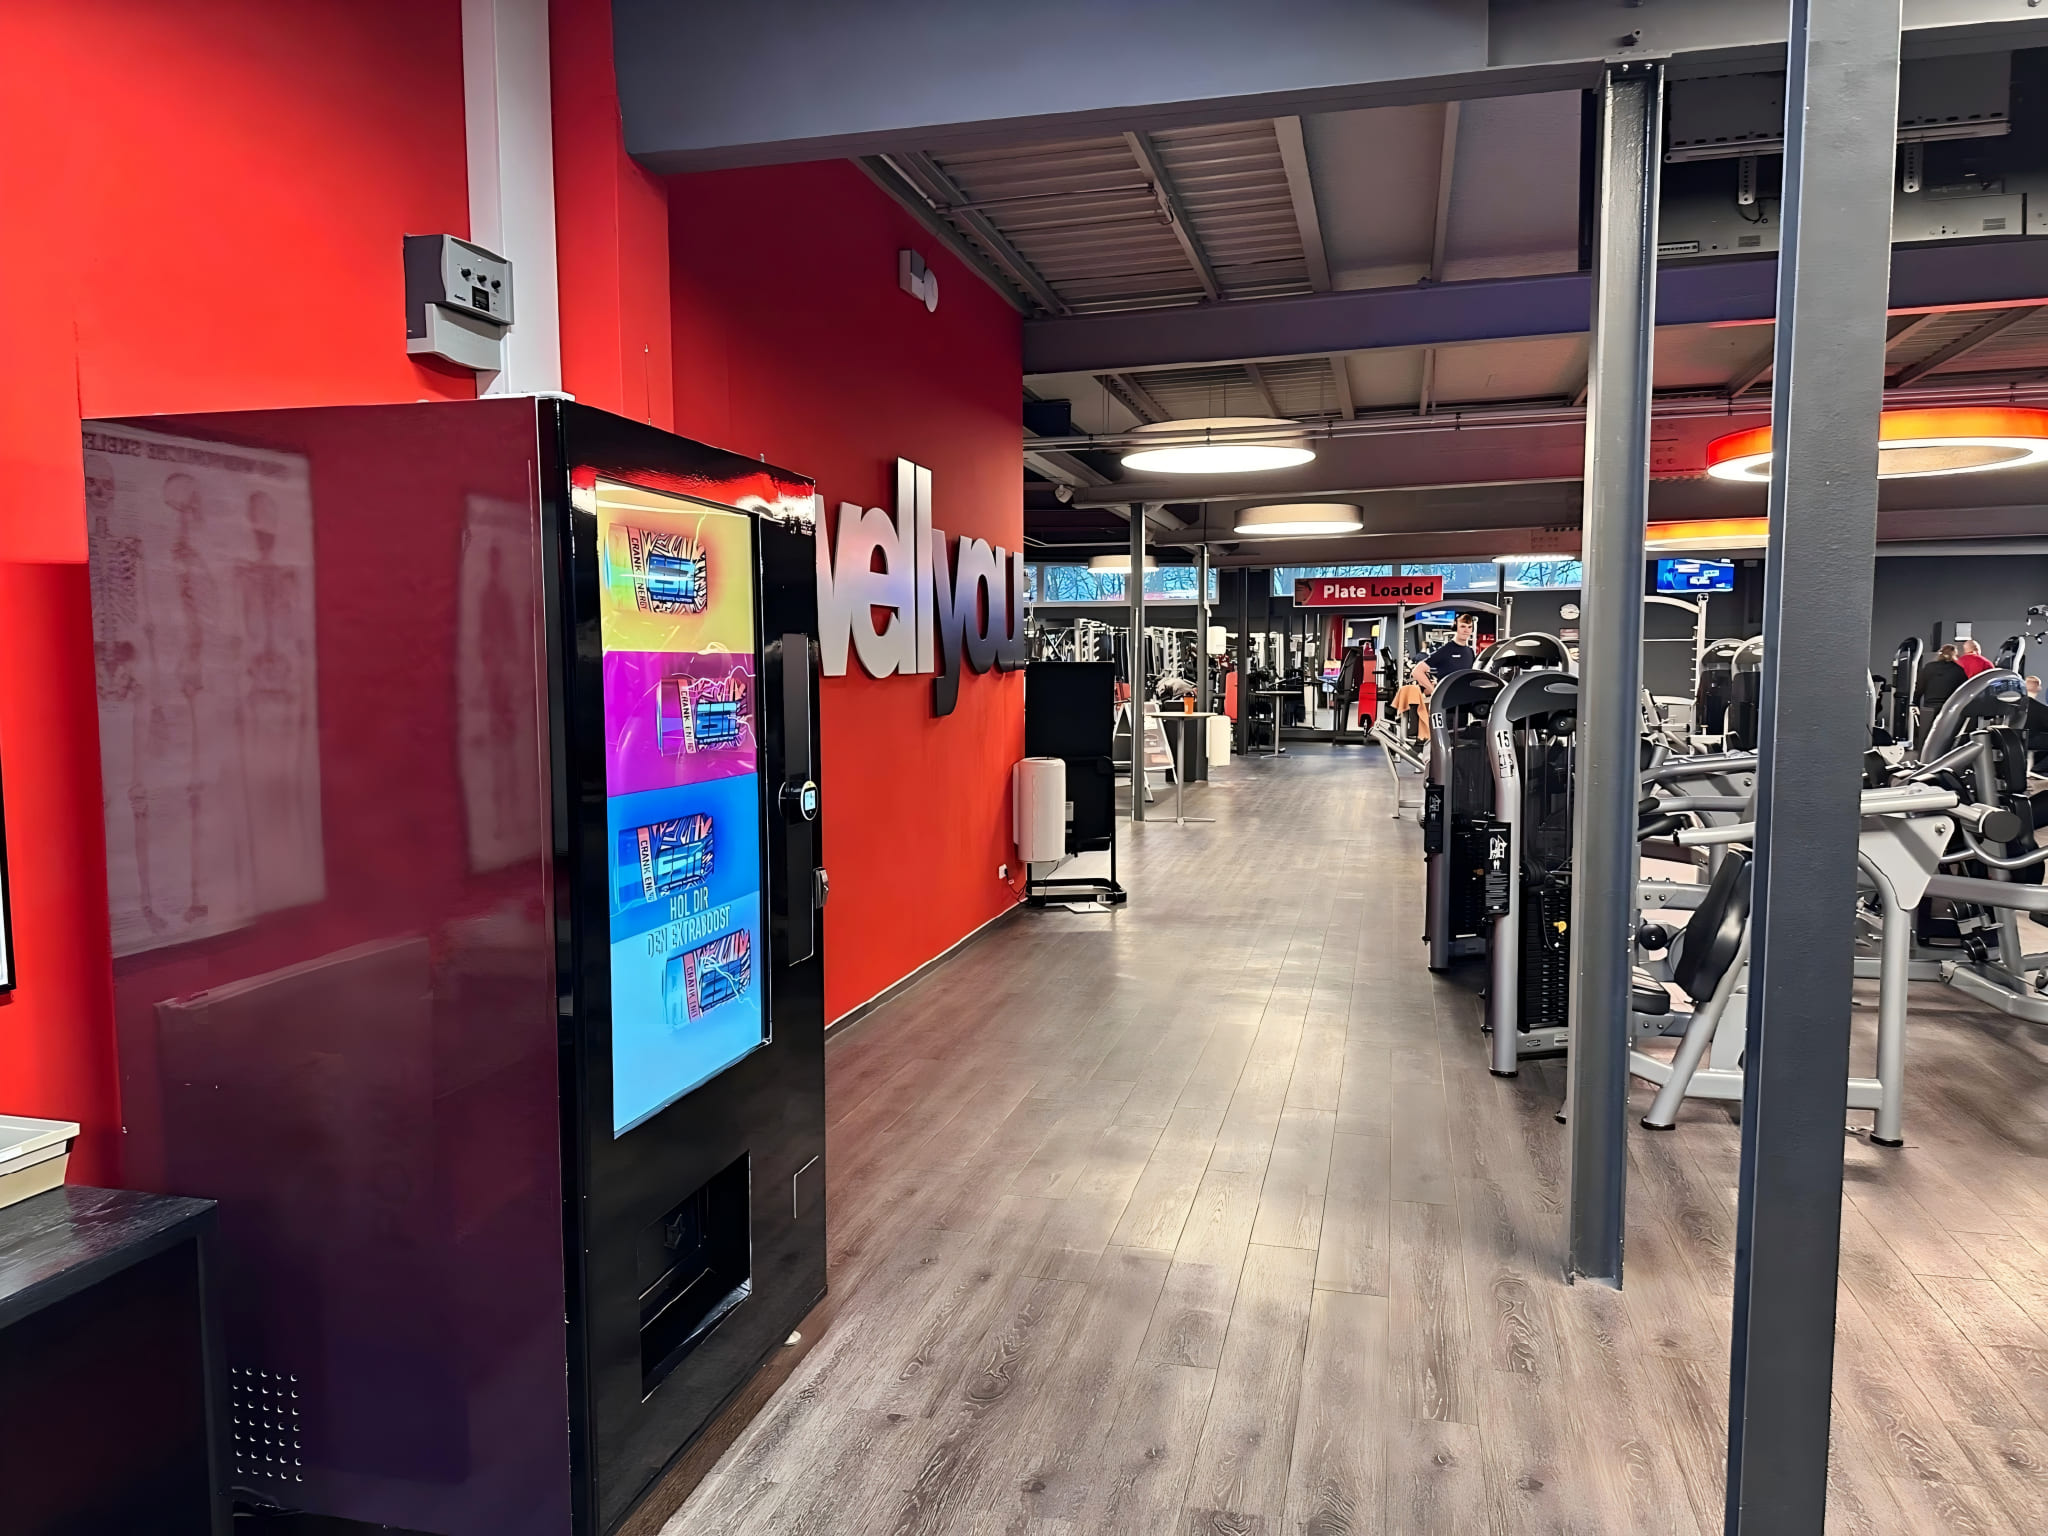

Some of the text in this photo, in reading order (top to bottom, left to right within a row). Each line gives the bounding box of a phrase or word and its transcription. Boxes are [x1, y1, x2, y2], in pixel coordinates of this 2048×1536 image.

[631, 537, 643, 572] CRANK
[1323, 581, 1434, 599] Plate Loaded
[1432, 713, 1443, 728] 15
[1497, 731, 1510, 748] 15
[640, 840, 652, 875] CRANK
[670, 886, 709, 921] HOL DIR
[647, 905, 731, 958] DEN EXTRABOOST
